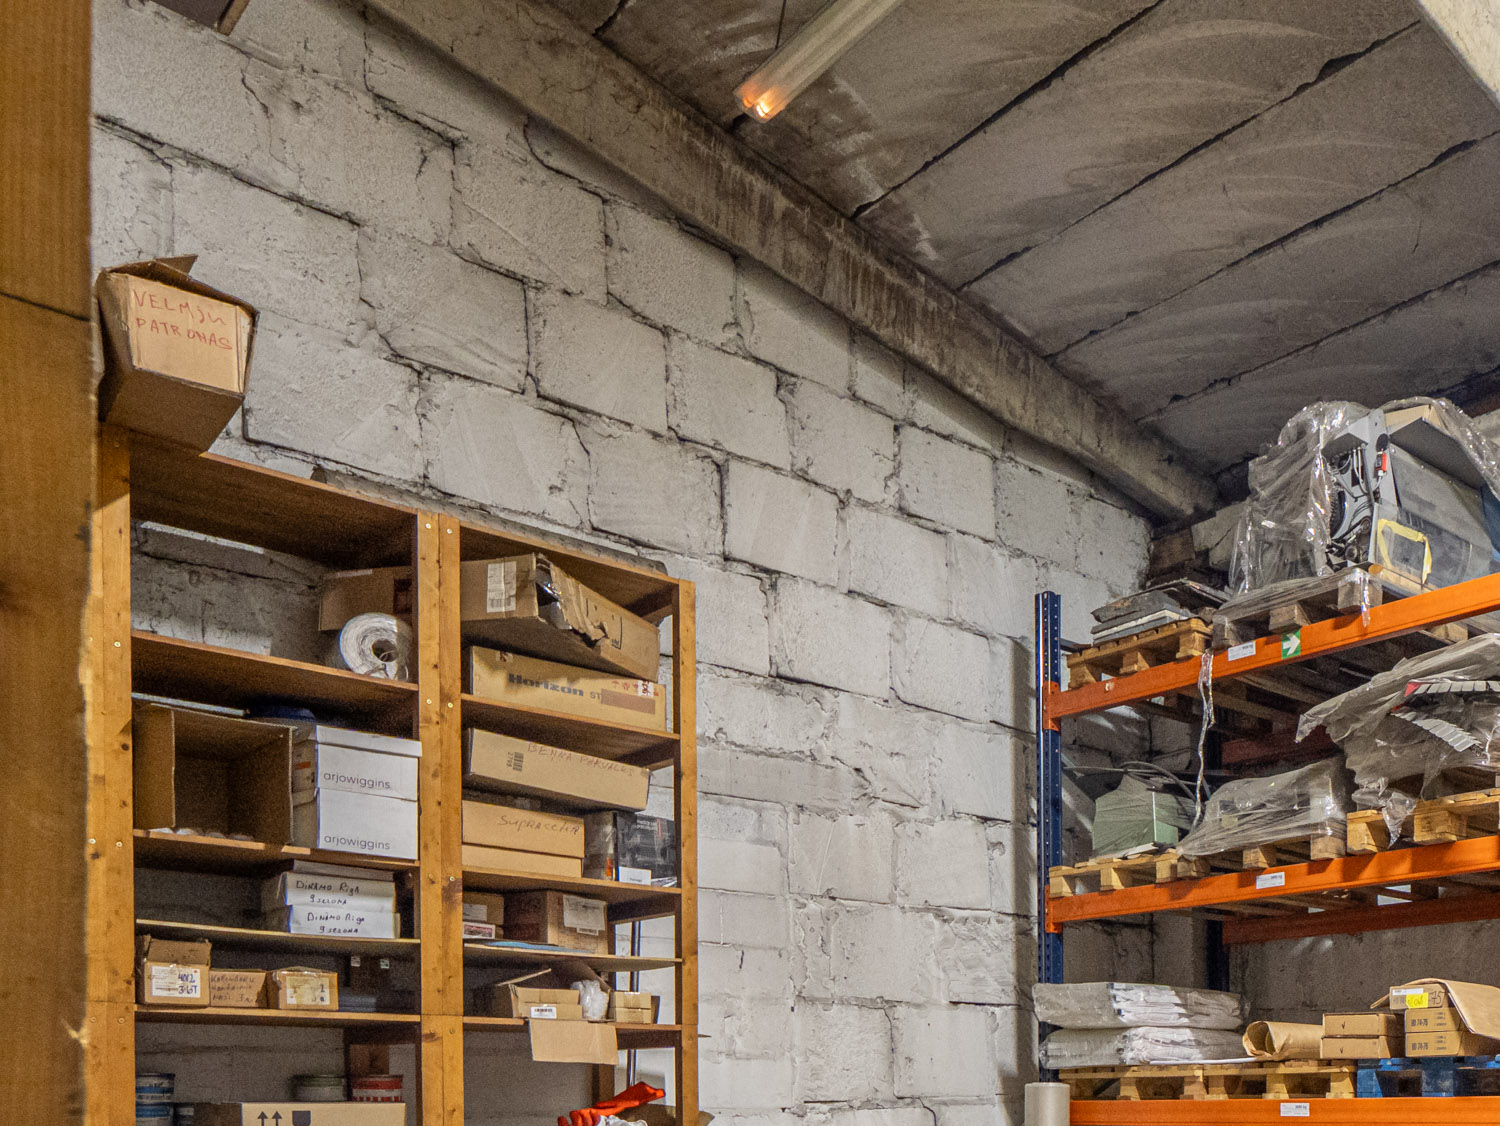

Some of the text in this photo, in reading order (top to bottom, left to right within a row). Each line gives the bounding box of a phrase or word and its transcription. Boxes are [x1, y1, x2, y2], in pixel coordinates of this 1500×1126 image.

[508, 672, 585, 698] Horizon
[324, 770, 391, 790] arjowiggins
[324, 833, 391, 851] arjowiggins
